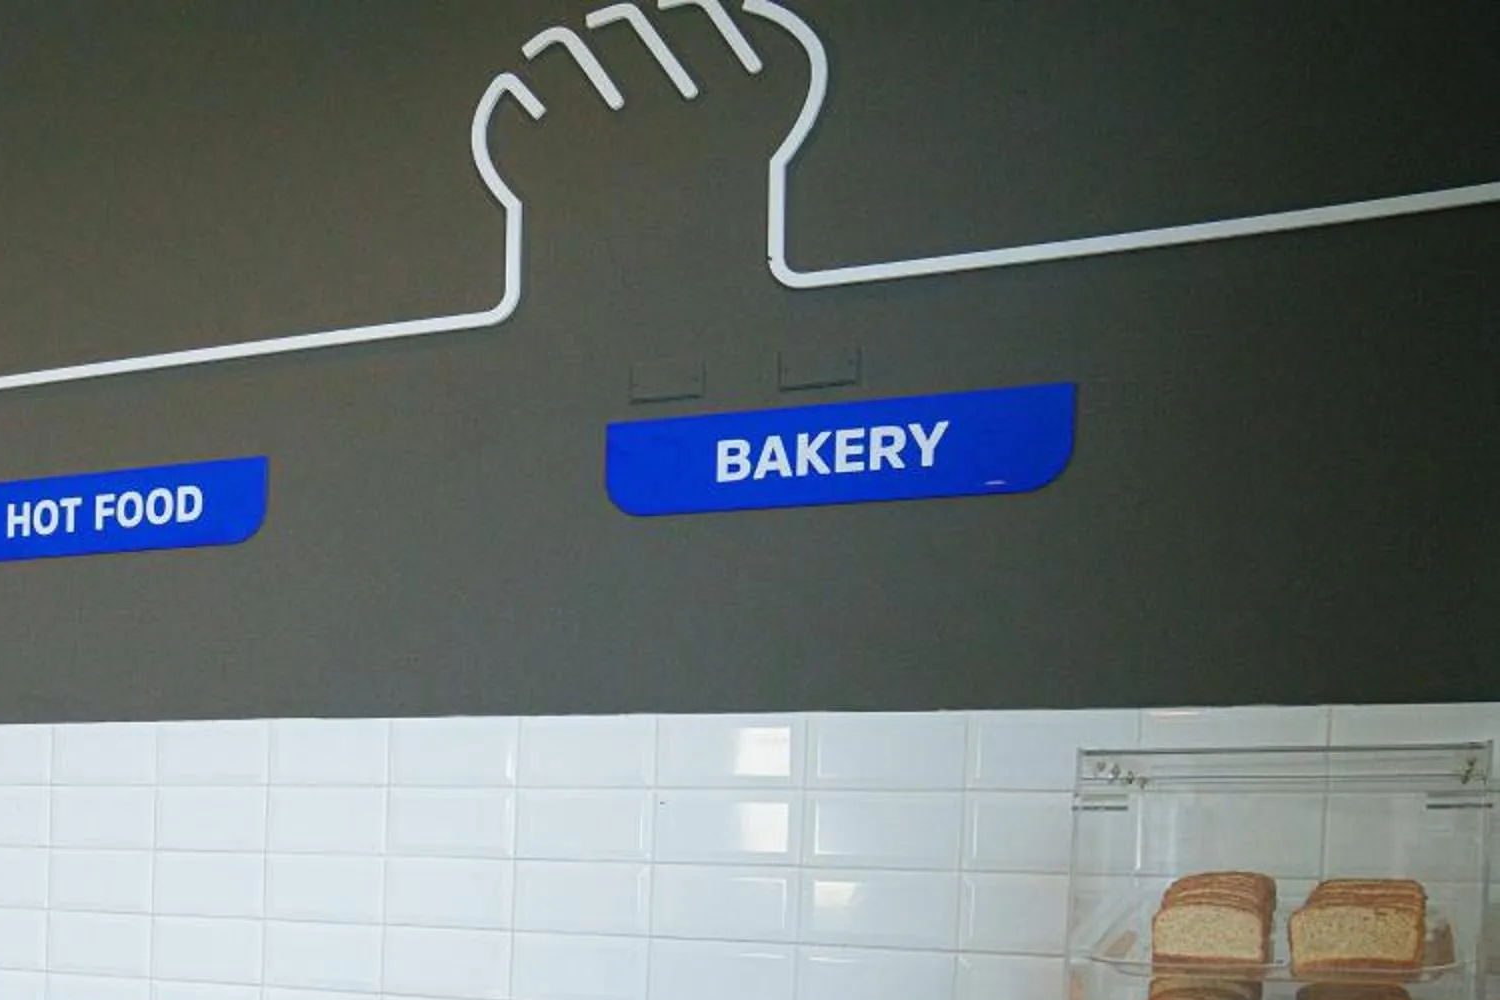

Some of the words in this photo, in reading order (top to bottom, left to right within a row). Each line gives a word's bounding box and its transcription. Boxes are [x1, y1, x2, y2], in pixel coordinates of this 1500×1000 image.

[716, 420, 949, 483] BAKERY
[7, 497, 82, 538] HOT
[95, 485, 203, 530] FOOD
